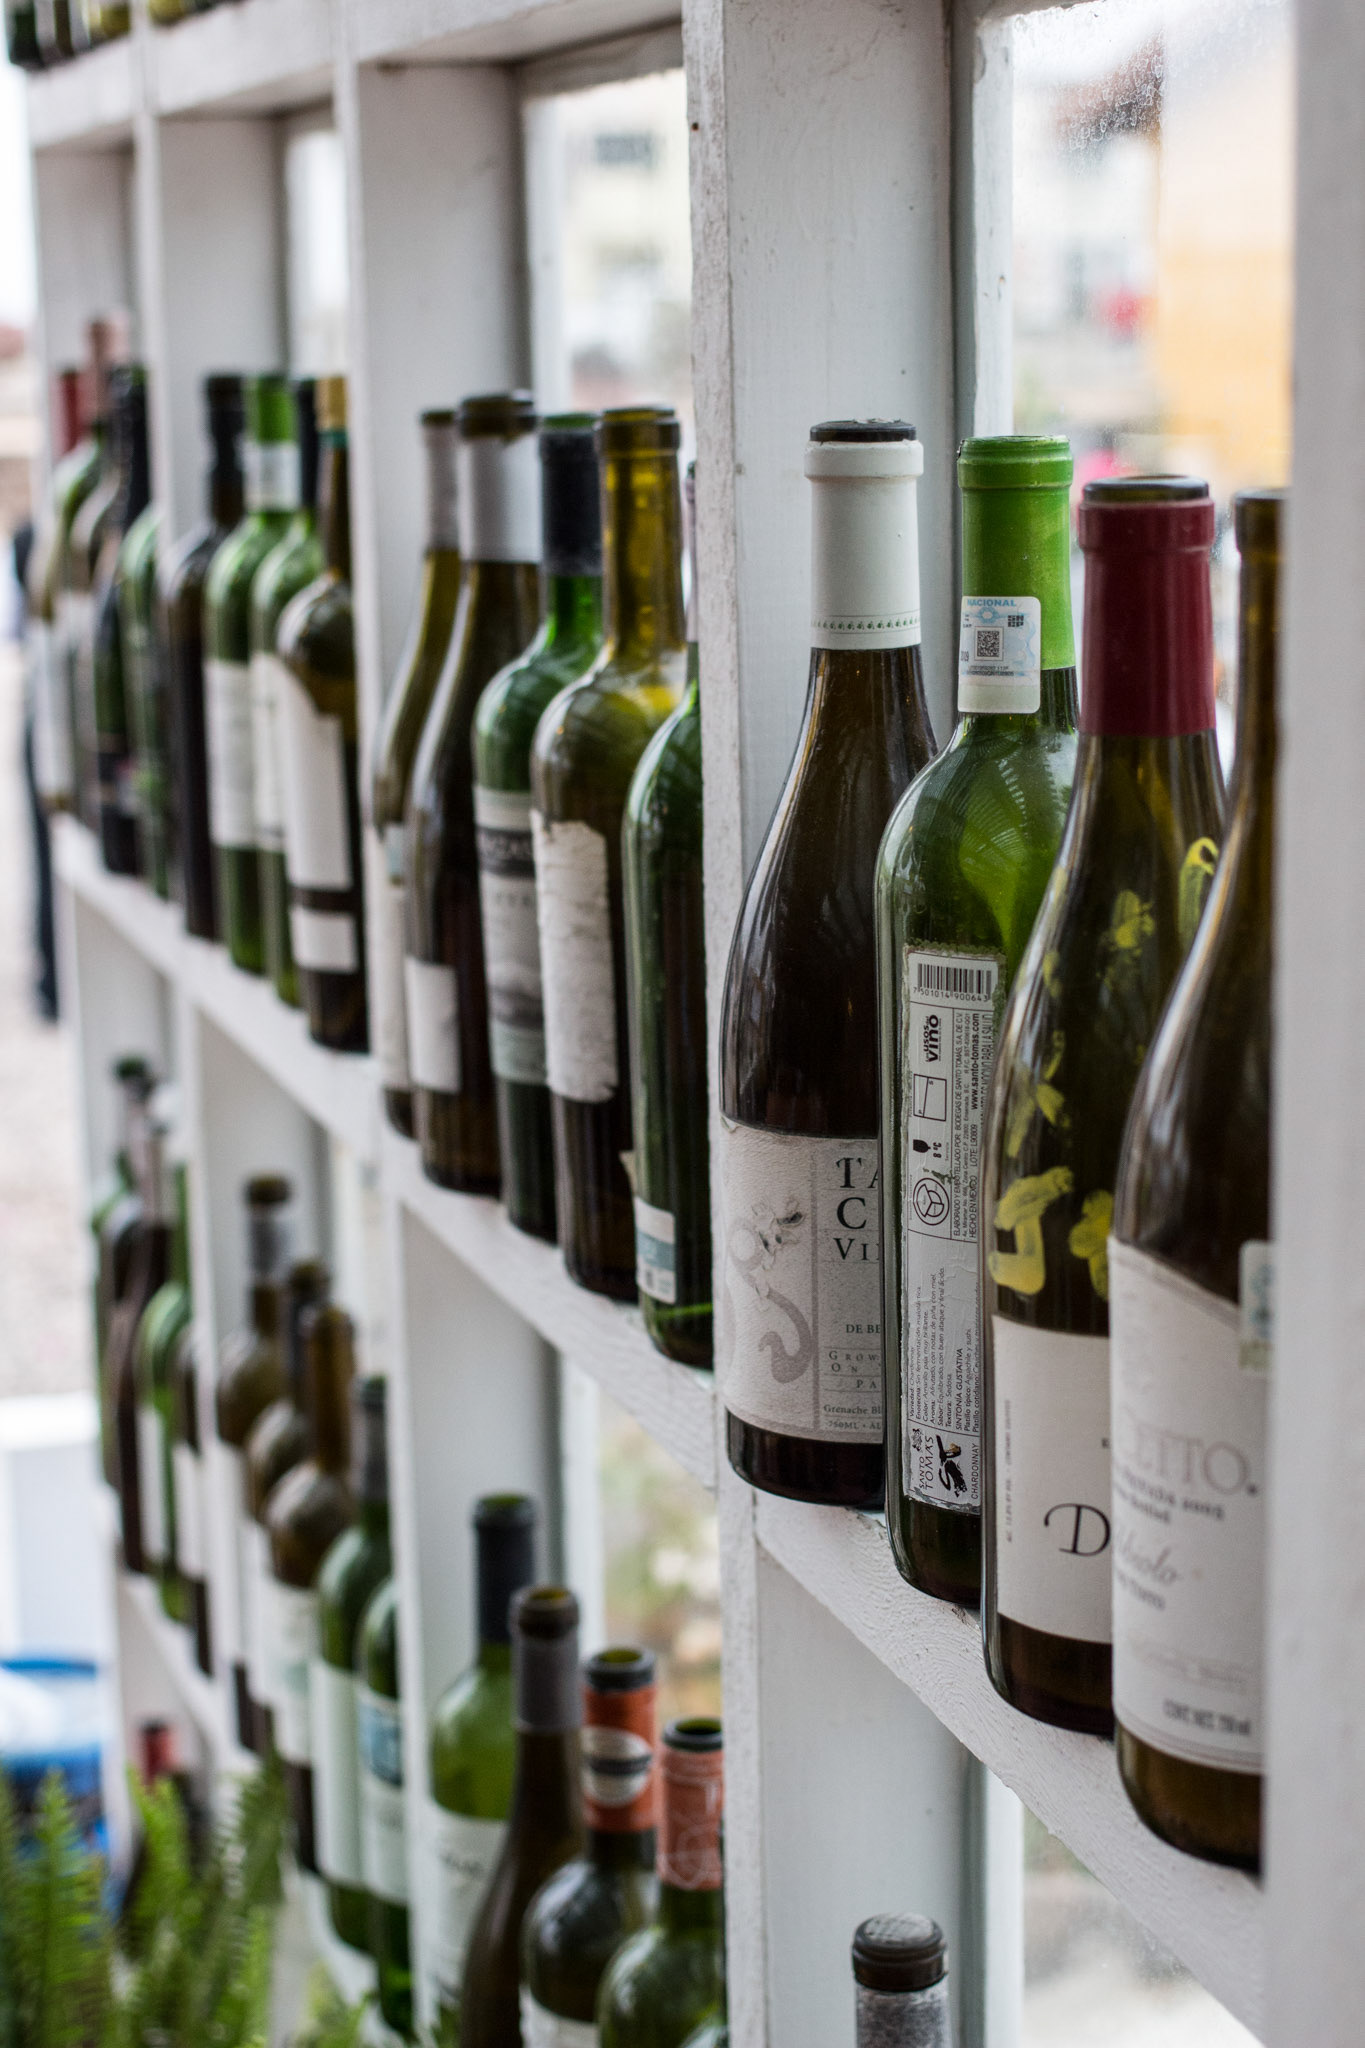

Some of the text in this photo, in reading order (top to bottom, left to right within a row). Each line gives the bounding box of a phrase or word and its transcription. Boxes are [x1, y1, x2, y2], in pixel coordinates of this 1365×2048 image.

[957, 1025, 962, 1033] DE
[928, 1015, 938, 1062] vino
[971, 1013, 979, 1110] www.santo-tomas.com
[955, 1092, 961, 1100] DE
[969, 1204, 976, 1212] EN
[833, 1238, 879, 1260] VI
[846, 1324, 863, 1333] DE
[931, 1321, 936, 1329] de
[824, 1405, 867, 1414] Grenache
[971, 1443, 979, 1499] CHARDONNAY
